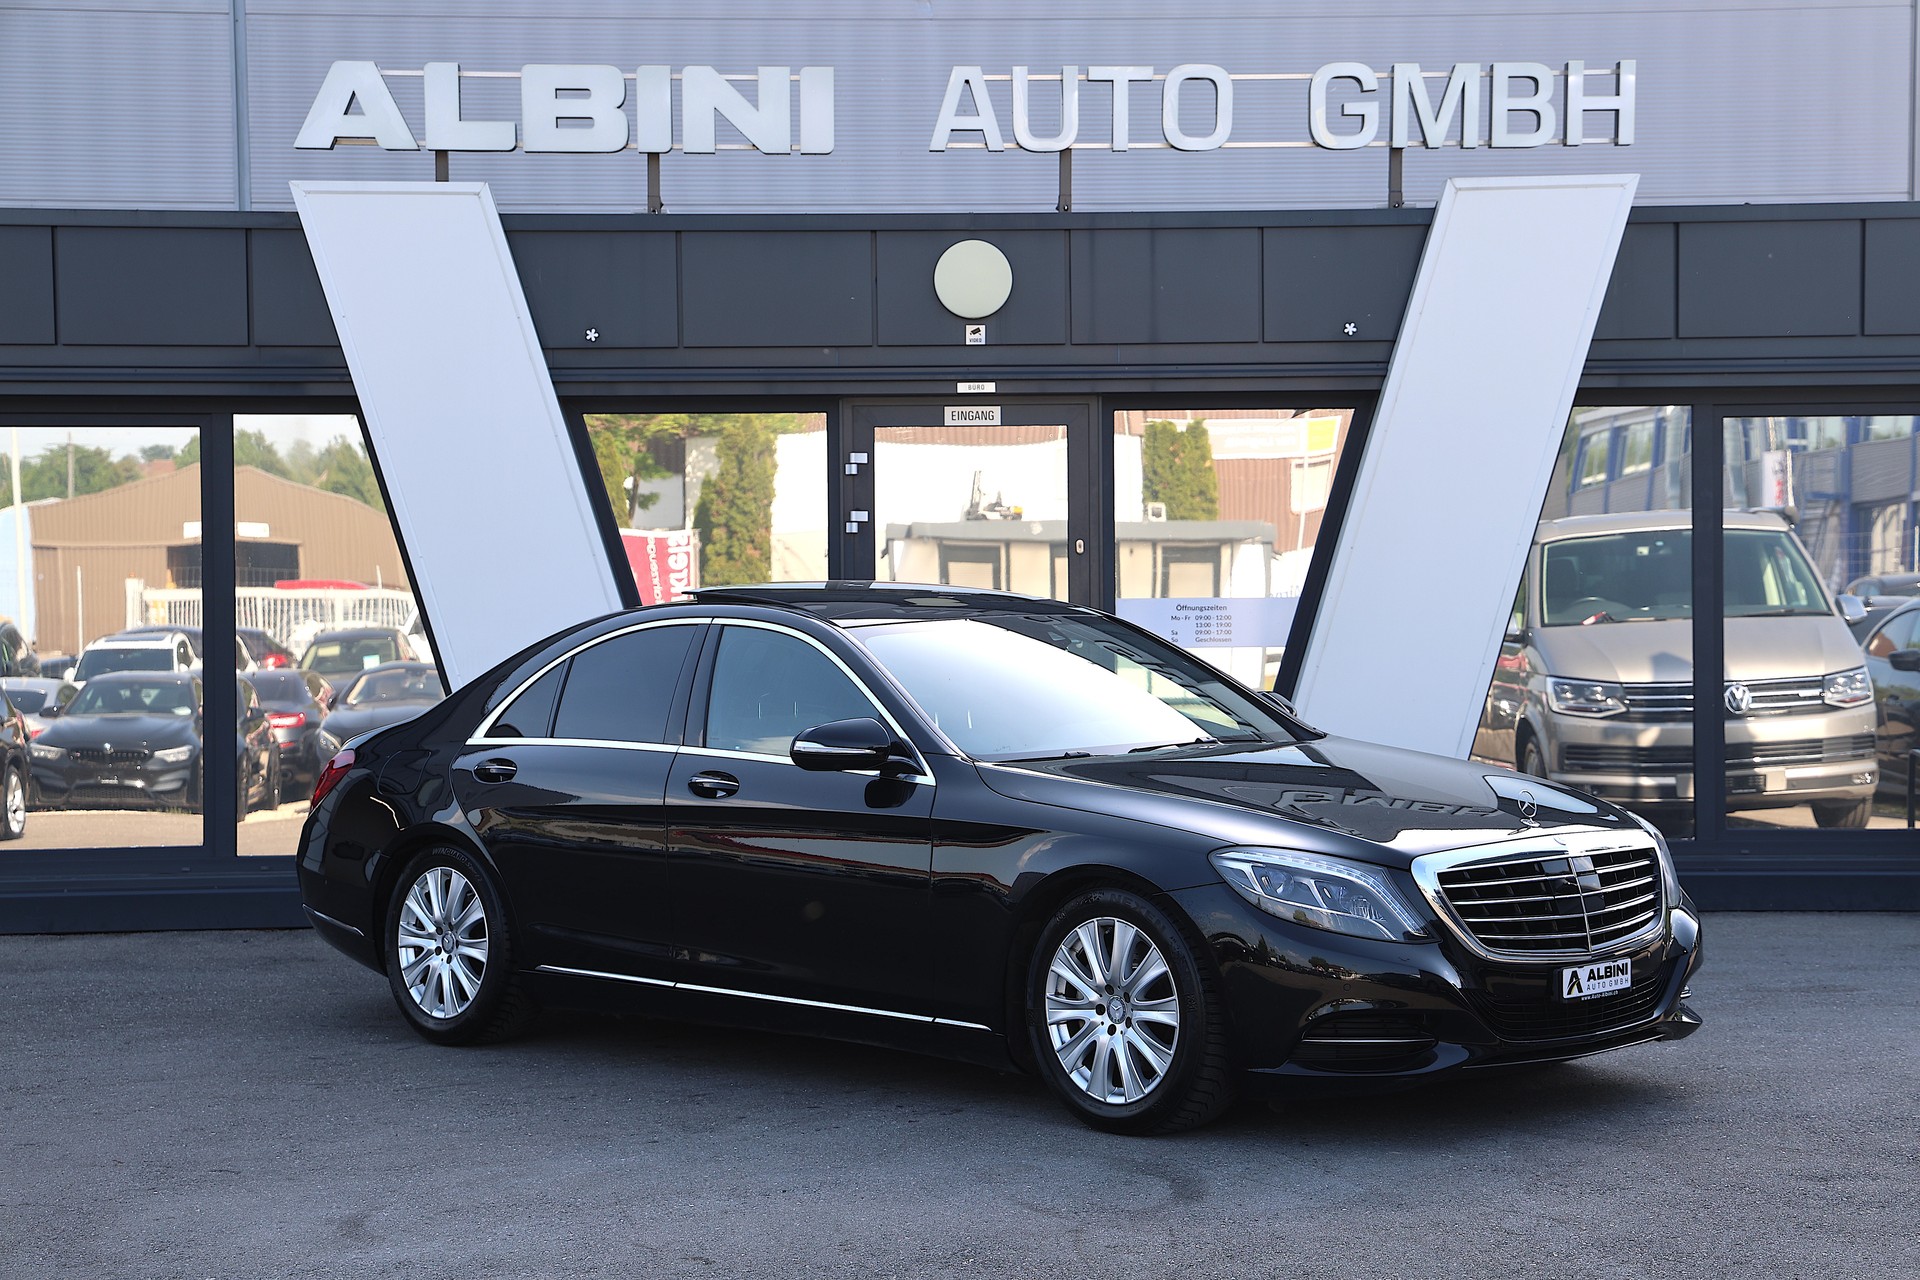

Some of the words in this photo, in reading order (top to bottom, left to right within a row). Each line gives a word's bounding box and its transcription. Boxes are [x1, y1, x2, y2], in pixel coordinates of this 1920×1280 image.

[293, 60, 835, 155] ALBINI
[929, 63, 1234, 152] AUTO
[1308, 59, 1637, 150] GMBH
[951, 410, 995, 421] EINGANG
[1176, 604, 1228, 612] Öffnungszeiten
[1109, 892, 1166, 933] NEXEN
[1586, 962, 1628, 982] ALBINI
[1586, 982, 1606, 991] AUTO
[1608, 978, 1628, 987] GMBH
